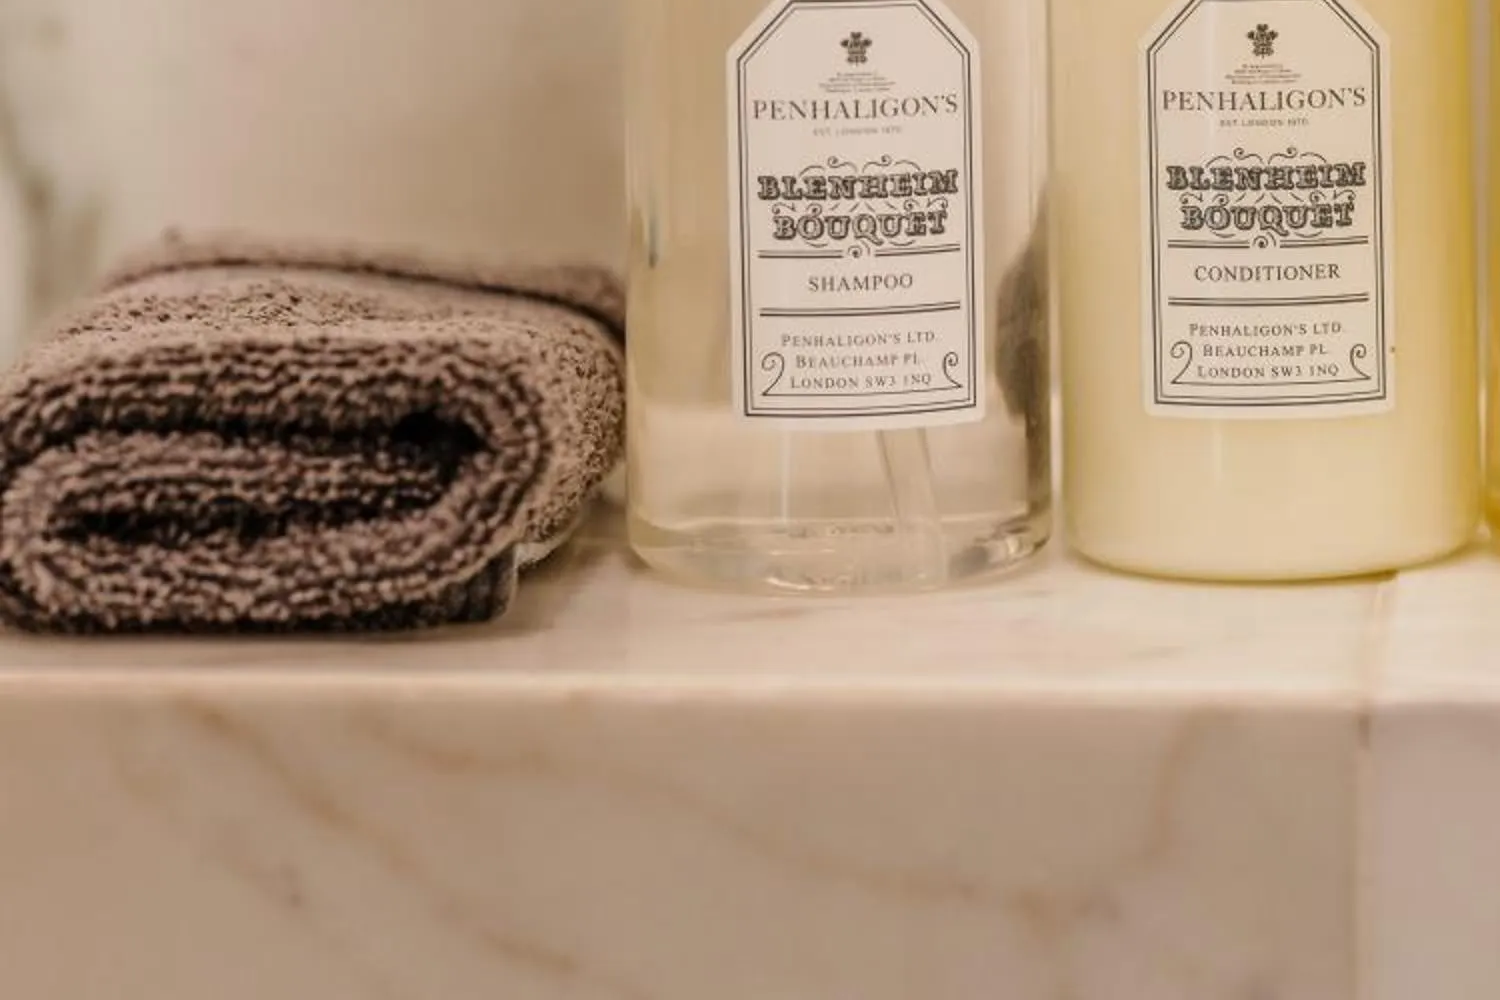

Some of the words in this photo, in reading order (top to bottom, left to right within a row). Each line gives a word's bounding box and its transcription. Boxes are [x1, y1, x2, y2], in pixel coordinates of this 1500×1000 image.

[752, 94, 958, 120] PENHALIGON'S
[1162, 87, 1366, 110] PENHALIGON'S
[757, 168, 959, 201] BLENHEIM
[1166, 161, 1366, 191] BLENHEIM
[773, 209, 948, 244] BOUQUET
[1181, 201, 1354, 235] BOUQUET
[1195, 264, 1341, 282] CONDITIONER
[809, 273, 913, 292] SHAMPOO
[1189, 323, 1307, 337] PENHALIGON'S
[781, 332, 901, 347] PENHALIGON'S
[1203, 345, 1304, 358] BEAUCHAMP
[796, 353, 899, 369] BEAUCHAMP
[1198, 366, 1265, 378] LONDON
[790, 376, 860, 389] LONDON
